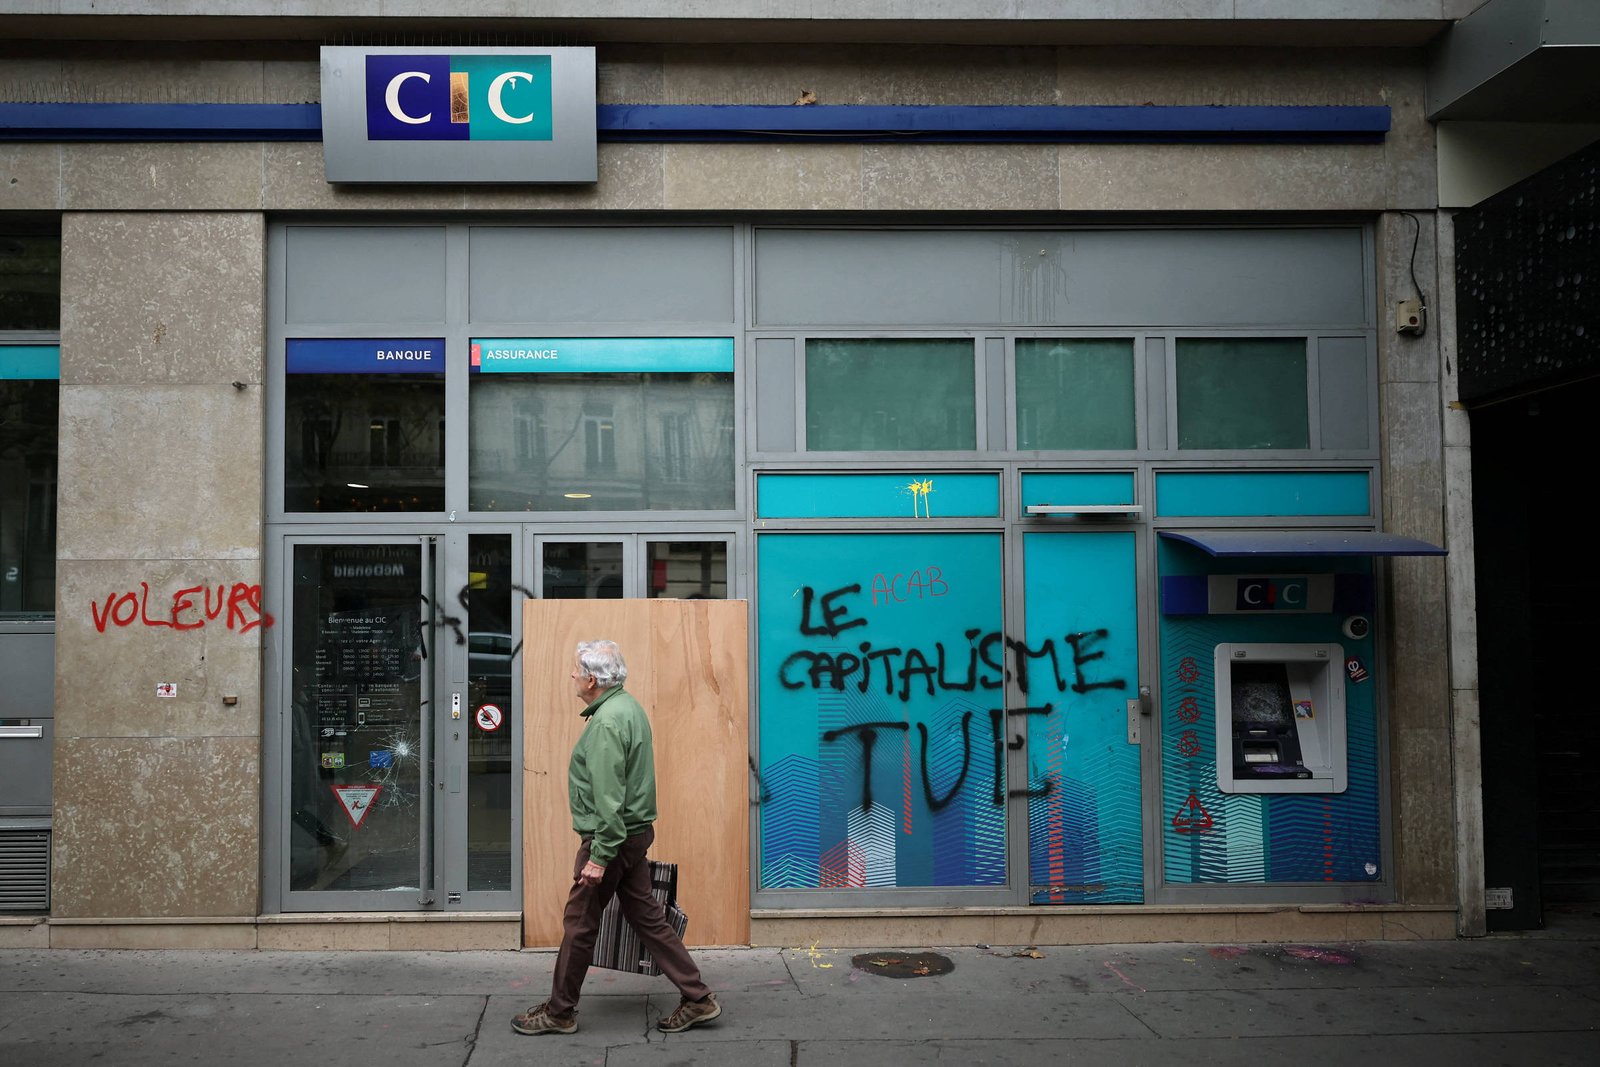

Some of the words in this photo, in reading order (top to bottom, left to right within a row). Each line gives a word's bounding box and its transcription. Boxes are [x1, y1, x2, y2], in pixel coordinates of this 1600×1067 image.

[385, 71, 534, 124] CIC
[377, 351, 432, 360] BANQUE
[486, 350, 558, 359] ASSURANCE
[872, 566, 948, 606] ACAB
[1243, 583, 1301, 605] CIC
[91, 581, 275, 633] VOLEURS
[375, 616, 387, 624] CIC
[800, 583, 868, 637] LE
[823, 703, 1053, 812] TUE
